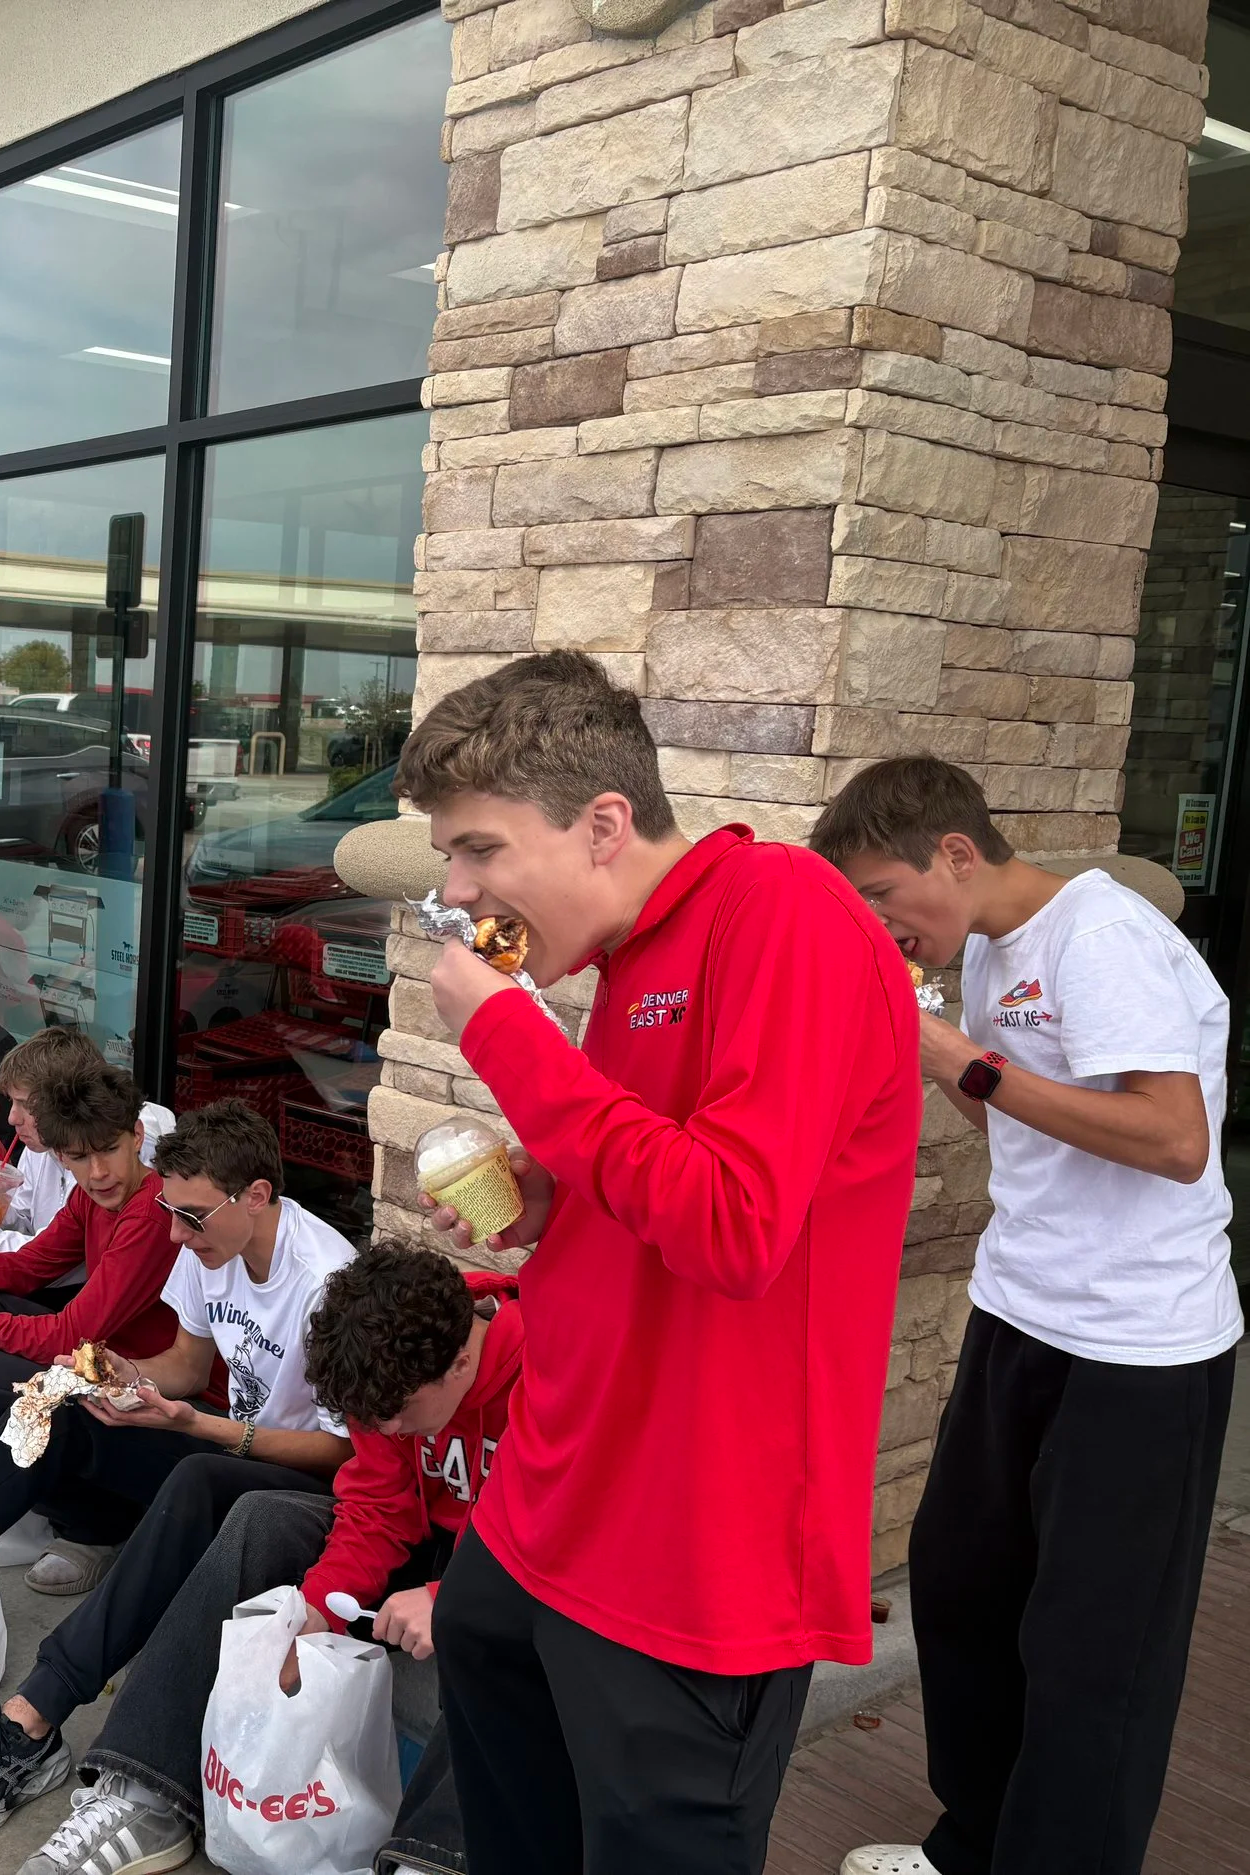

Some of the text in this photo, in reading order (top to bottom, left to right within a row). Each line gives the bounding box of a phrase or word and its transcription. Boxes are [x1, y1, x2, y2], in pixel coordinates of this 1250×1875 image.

[1185, 831, 1201, 846] We
[1180, 842, 1204, 858] Card
[111, 949, 125, 963] STEEL
[641, 989, 689, 1008] DENVER
[630, 1006, 687, 1029] EAST XC
[1000, 1010, 1041, 1027] EAST XC
[204, 1742, 336, 1822] BUC-EE'S
